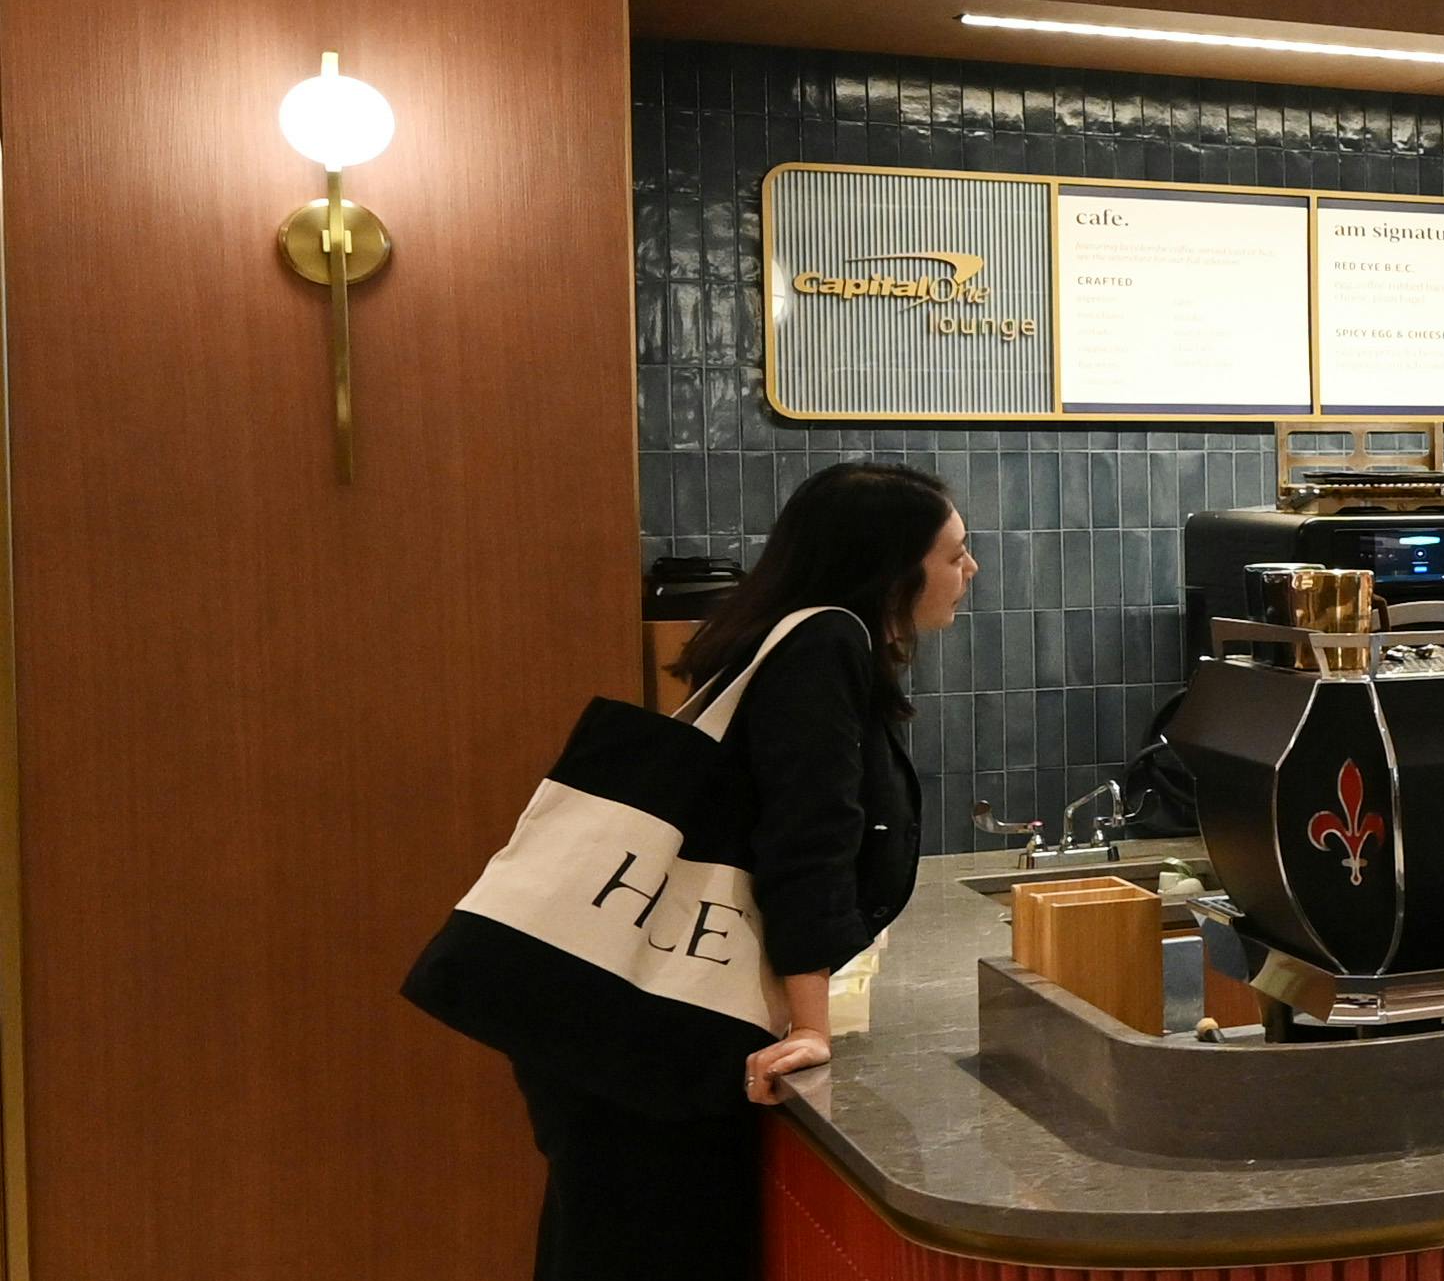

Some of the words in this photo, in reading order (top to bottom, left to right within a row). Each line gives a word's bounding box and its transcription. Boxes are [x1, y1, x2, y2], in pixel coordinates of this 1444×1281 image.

[1075, 208, 1130, 227] cafe.
[1333, 223, 1366, 238] am
[1334, 261, 1356, 270] RED
[1360, 262, 1380, 271] EYE
[793, 271, 931, 299] Capital
[930, 276, 990, 304] One
[1077, 275, 1133, 287] CRAFTED
[929, 310, 1037, 342] lounge
[1335, 328, 1367, 338] SPICY
[1371, 329, 1393, 339] EGG
[1396, 330, 1404, 339] &
